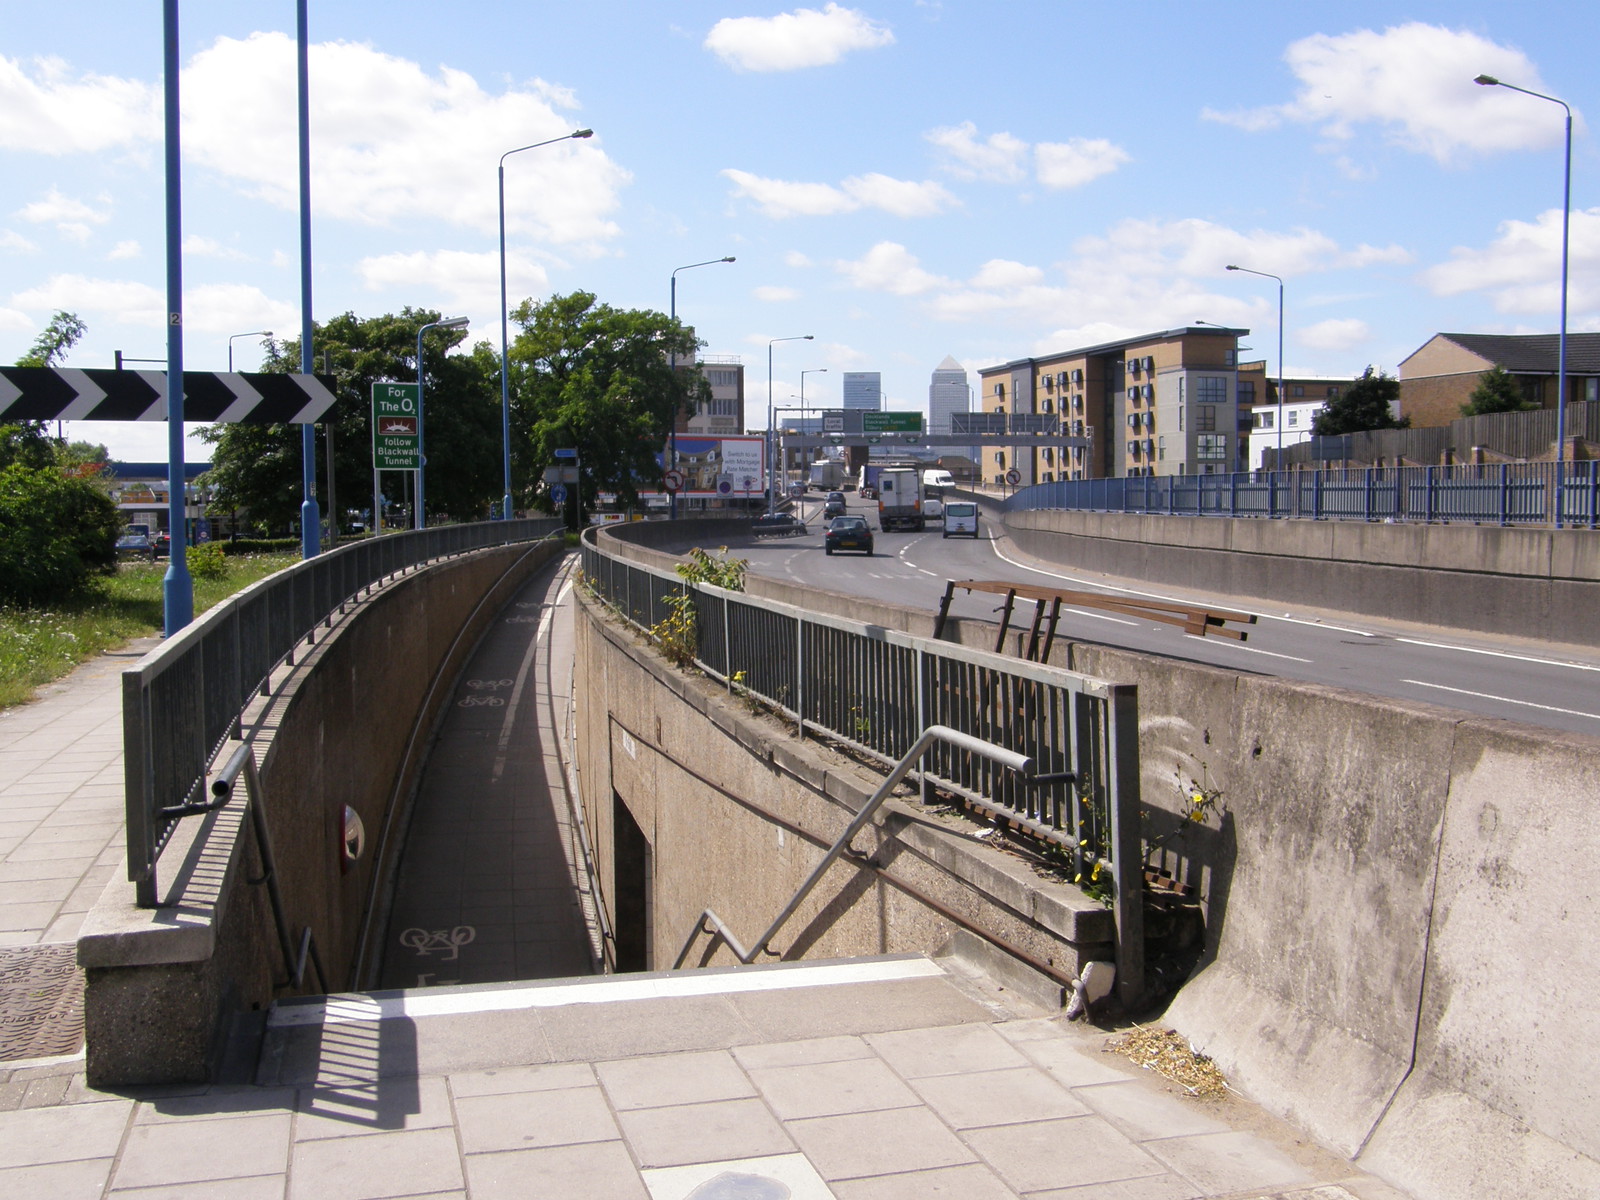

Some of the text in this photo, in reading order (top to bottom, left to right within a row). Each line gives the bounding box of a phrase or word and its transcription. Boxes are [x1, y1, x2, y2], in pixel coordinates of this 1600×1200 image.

[388, 387, 406, 397] For
[380, 401, 399, 411] The
[385, 437, 411, 446] follow
[378, 447, 419, 455] Blackwall
[384, 457, 412, 465] Tunnel
